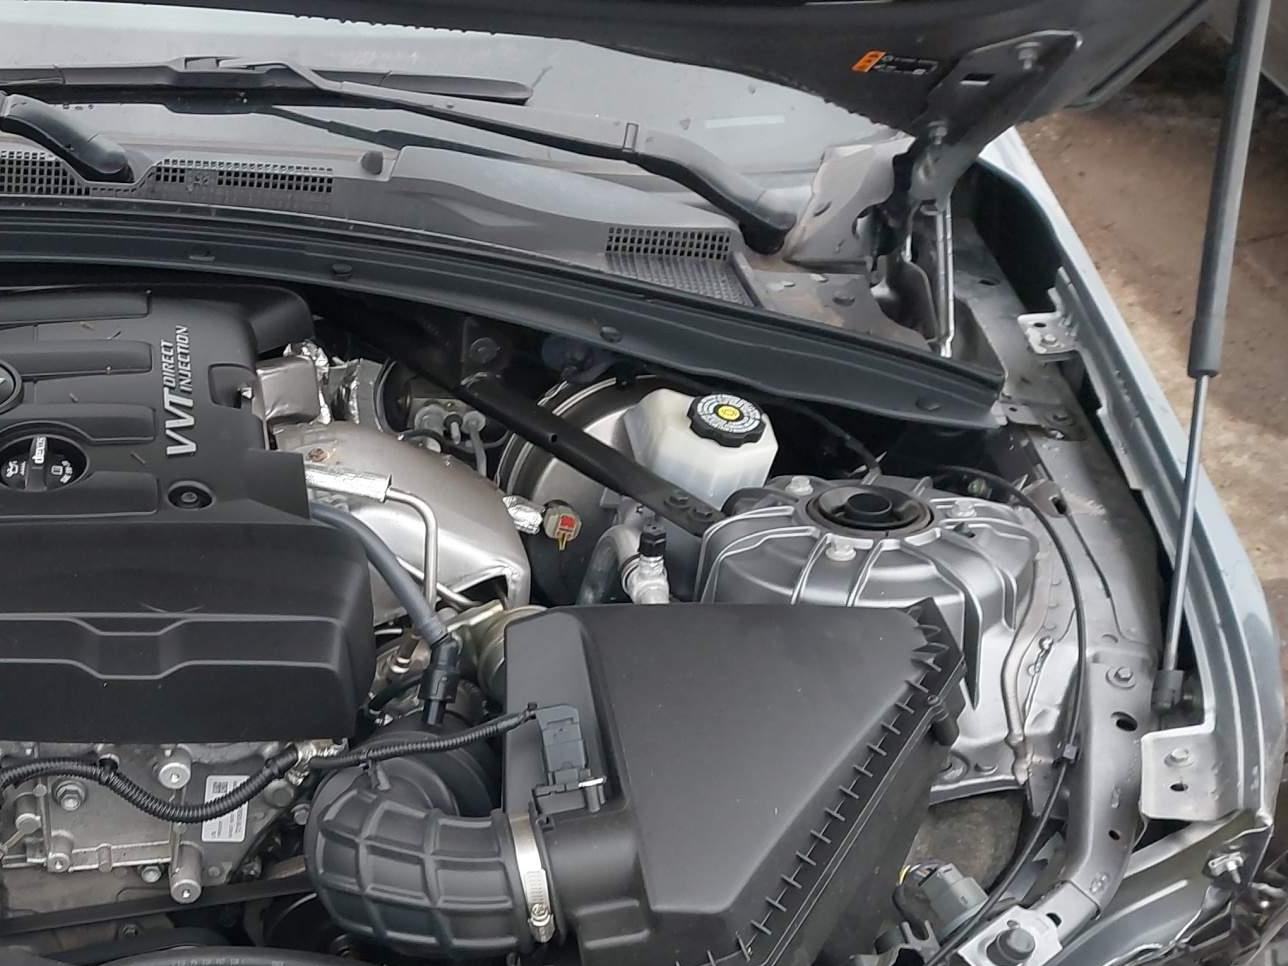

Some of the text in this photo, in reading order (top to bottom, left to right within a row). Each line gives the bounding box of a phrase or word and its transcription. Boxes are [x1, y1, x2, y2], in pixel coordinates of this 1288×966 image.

[161, 339, 197, 456] VVT DIRECT
[175, 325, 193, 392] INJECTION
